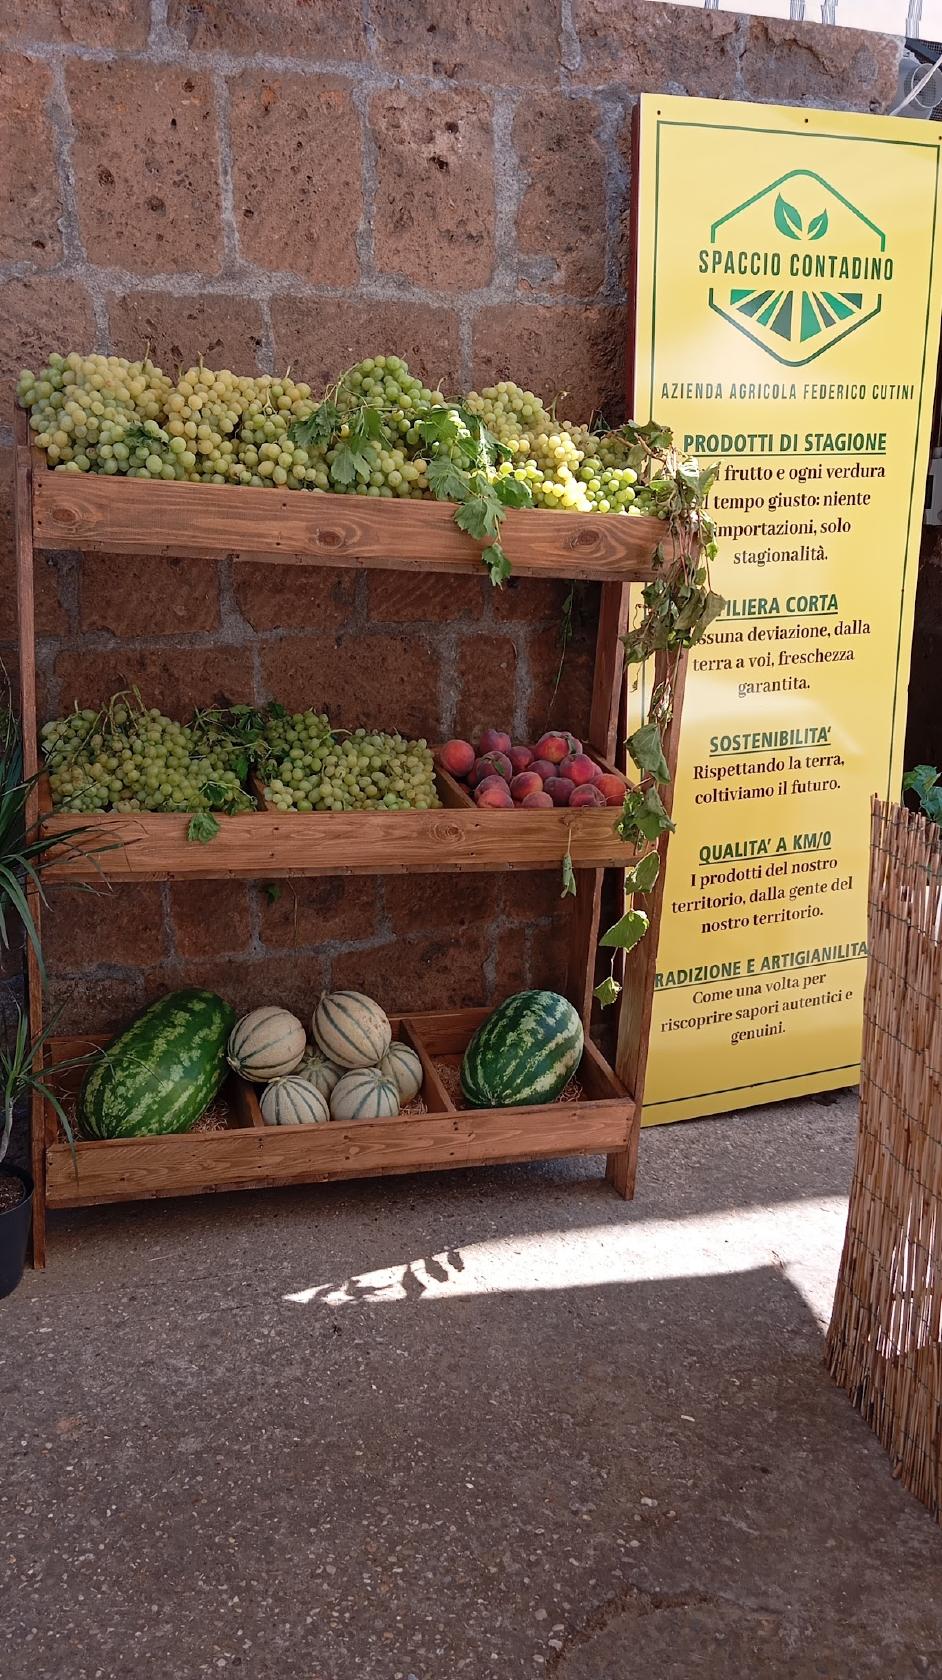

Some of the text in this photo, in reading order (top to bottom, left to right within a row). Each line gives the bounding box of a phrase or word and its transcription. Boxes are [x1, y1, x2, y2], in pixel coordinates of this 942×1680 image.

[699, 250, 893, 280] SPACCIO CONTADINO
[661, 383, 915, 400] AZIENDA AGRICOLA FEDERICO CUTINI
[683, 433, 887, 452] PRODOTTI DI STAGIONE
[725, 465, 773, 481] frutto
[777, 468, 785, 479] e
[789, 464, 823, 483] ogni
[826, 463, 885, 479] verdura
[714, 497, 765, 512] tempo
[768, 493, 820, 511] giusto:
[824, 491, 871, 507] niente
[820, 518, 851, 534] solo
[733, 546, 828, 566] stagionalità.
[717, 593, 838, 617] ILIERA CORTA
[693, 620, 871, 645] ssuna deviazione, dalla
[693, 648, 854, 671] terra a voi, freschezza
[738, 678, 810, 698] garantita.
[693, 754, 844, 780] Rispettando la terra,
[695, 778, 841, 804] coltiviamo il futuro.
[776, 836, 787, 852] A
[690, 858, 838, 888] I prodotti del nostro
[671, 877, 853, 913] territorio, dalla gente del
[701, 905, 824, 933] nostro territorio.
[747, 959, 755, 974] E
[692, 973, 826, 1004] Come una volta per
[661, 990, 853, 1033] riscoprire sapori autentici e
[731, 1022, 786, 1045] genuini.
